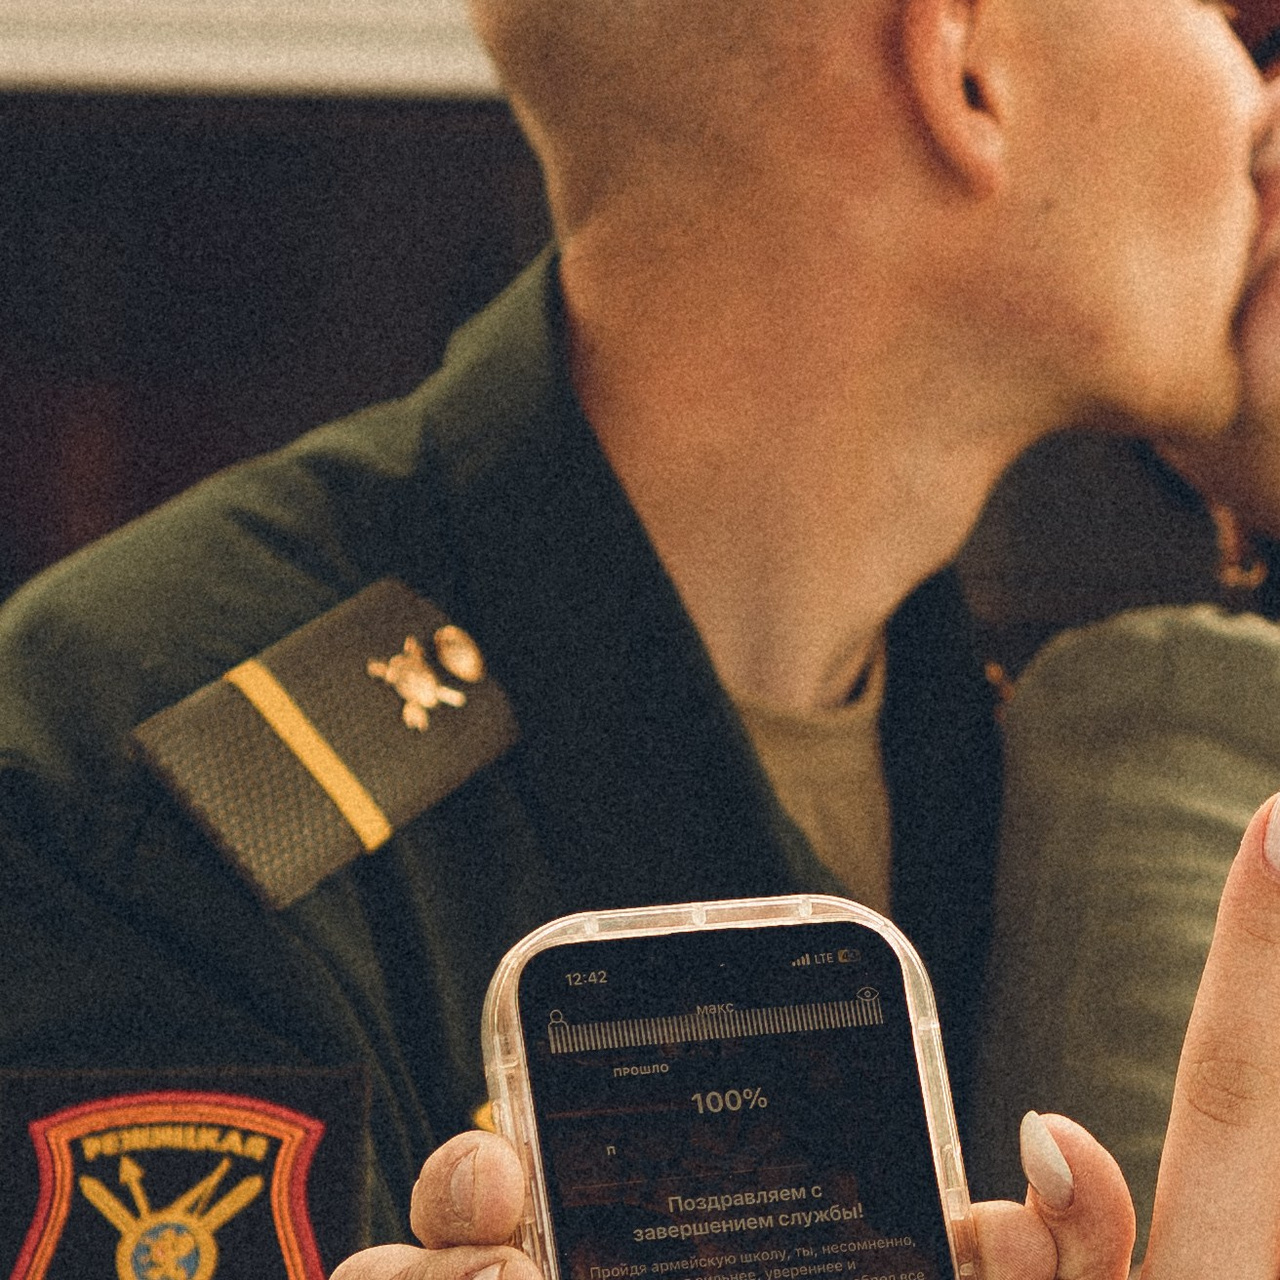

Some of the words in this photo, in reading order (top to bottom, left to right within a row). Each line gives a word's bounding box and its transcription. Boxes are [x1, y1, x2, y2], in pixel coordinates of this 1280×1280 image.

[814, 952, 834, 964] LTE
[565, 970, 608, 987] 12:42
[613, 1062, 669, 1078] прошло
[691, 1087, 768, 1114] 100%
[667, 1185, 806, 1213] Поздравляем
[811, 1185, 823, 1198] с
[632, 1214, 774, 1242] завершением
[778, 1202, 864, 1228] службы!
[589, 1263, 647, 1280] Пройдя
[651, 1254, 736, 1274] армейскую
[740, 1248, 791, 1264] школу,
[795, 1246, 818, 1258] ты,
[821, 1236, 916, 1255] несомненно,
[847, 1260, 856, 1270] и
